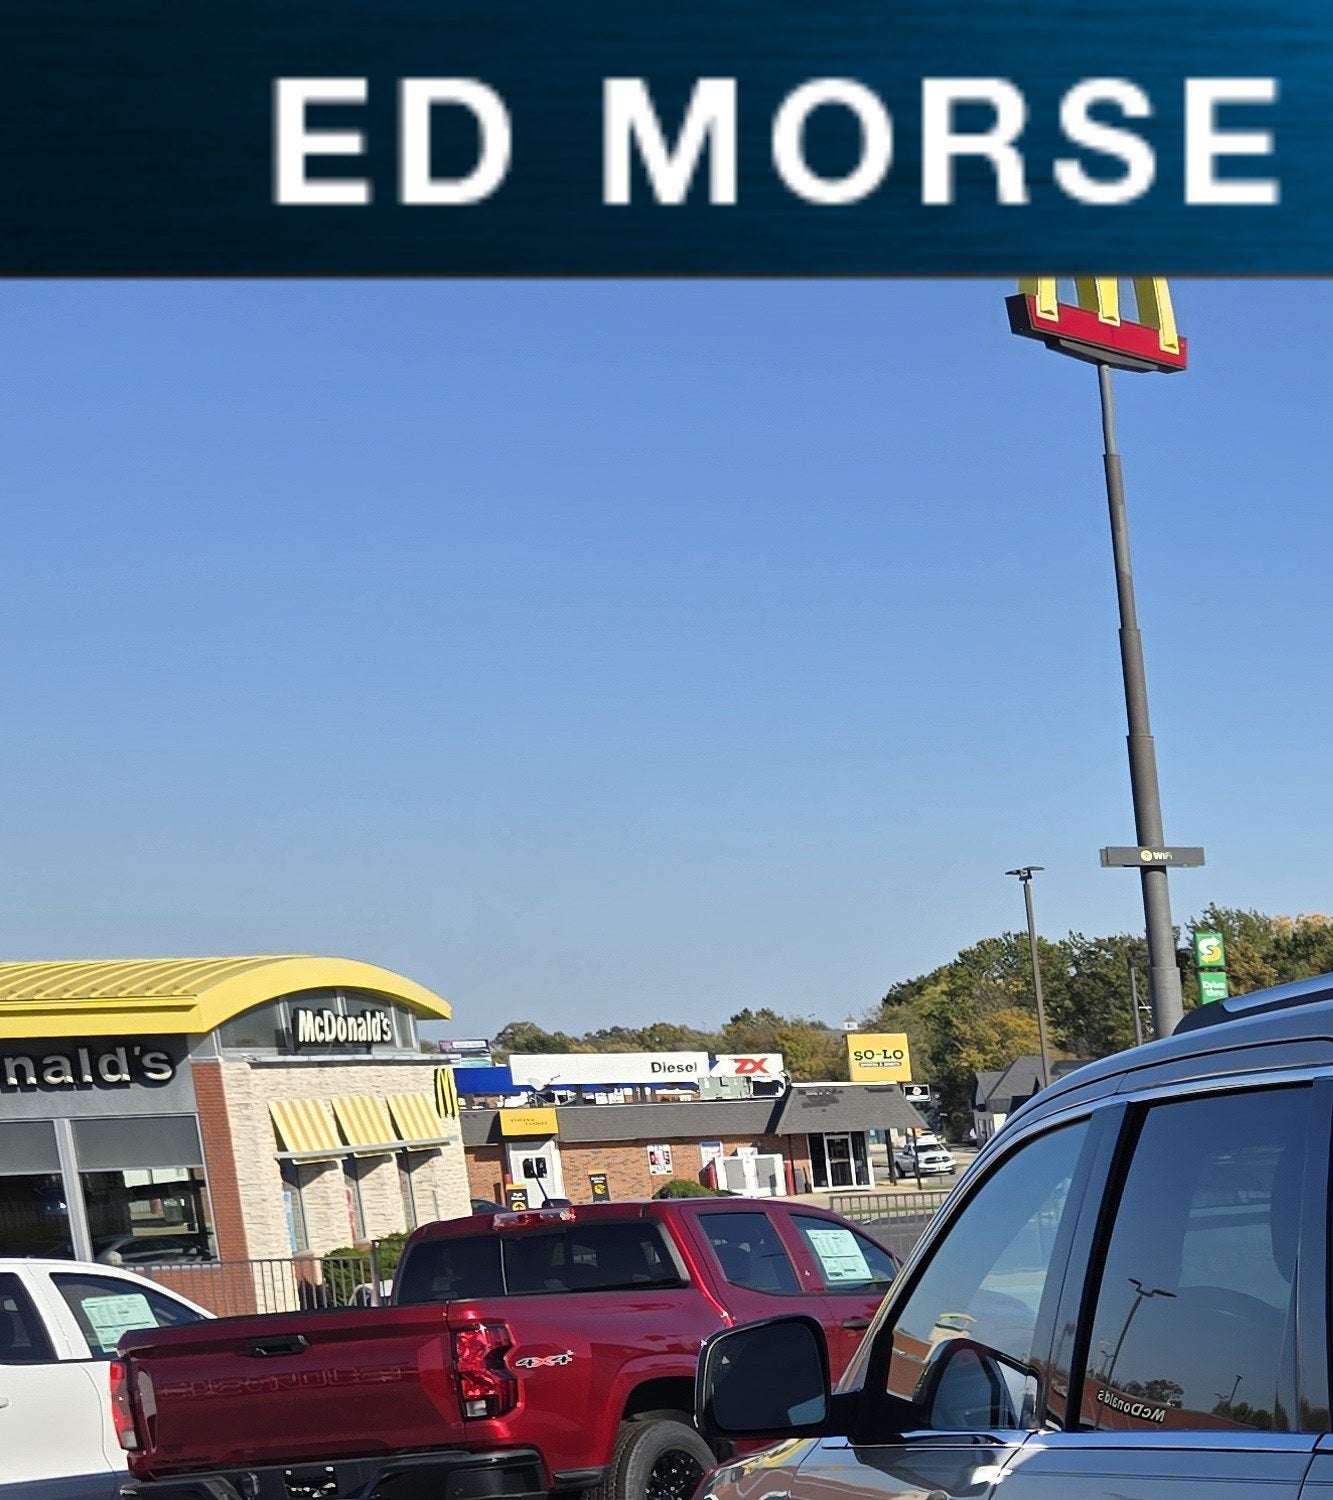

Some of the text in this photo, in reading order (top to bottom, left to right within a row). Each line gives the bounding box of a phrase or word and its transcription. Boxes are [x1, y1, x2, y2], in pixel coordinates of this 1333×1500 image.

[298, 1008, 392, 1043] McDonald's
[853, 1049, 904, 1061] SO-LO
[651, 1061, 698, 1074] Diesel
